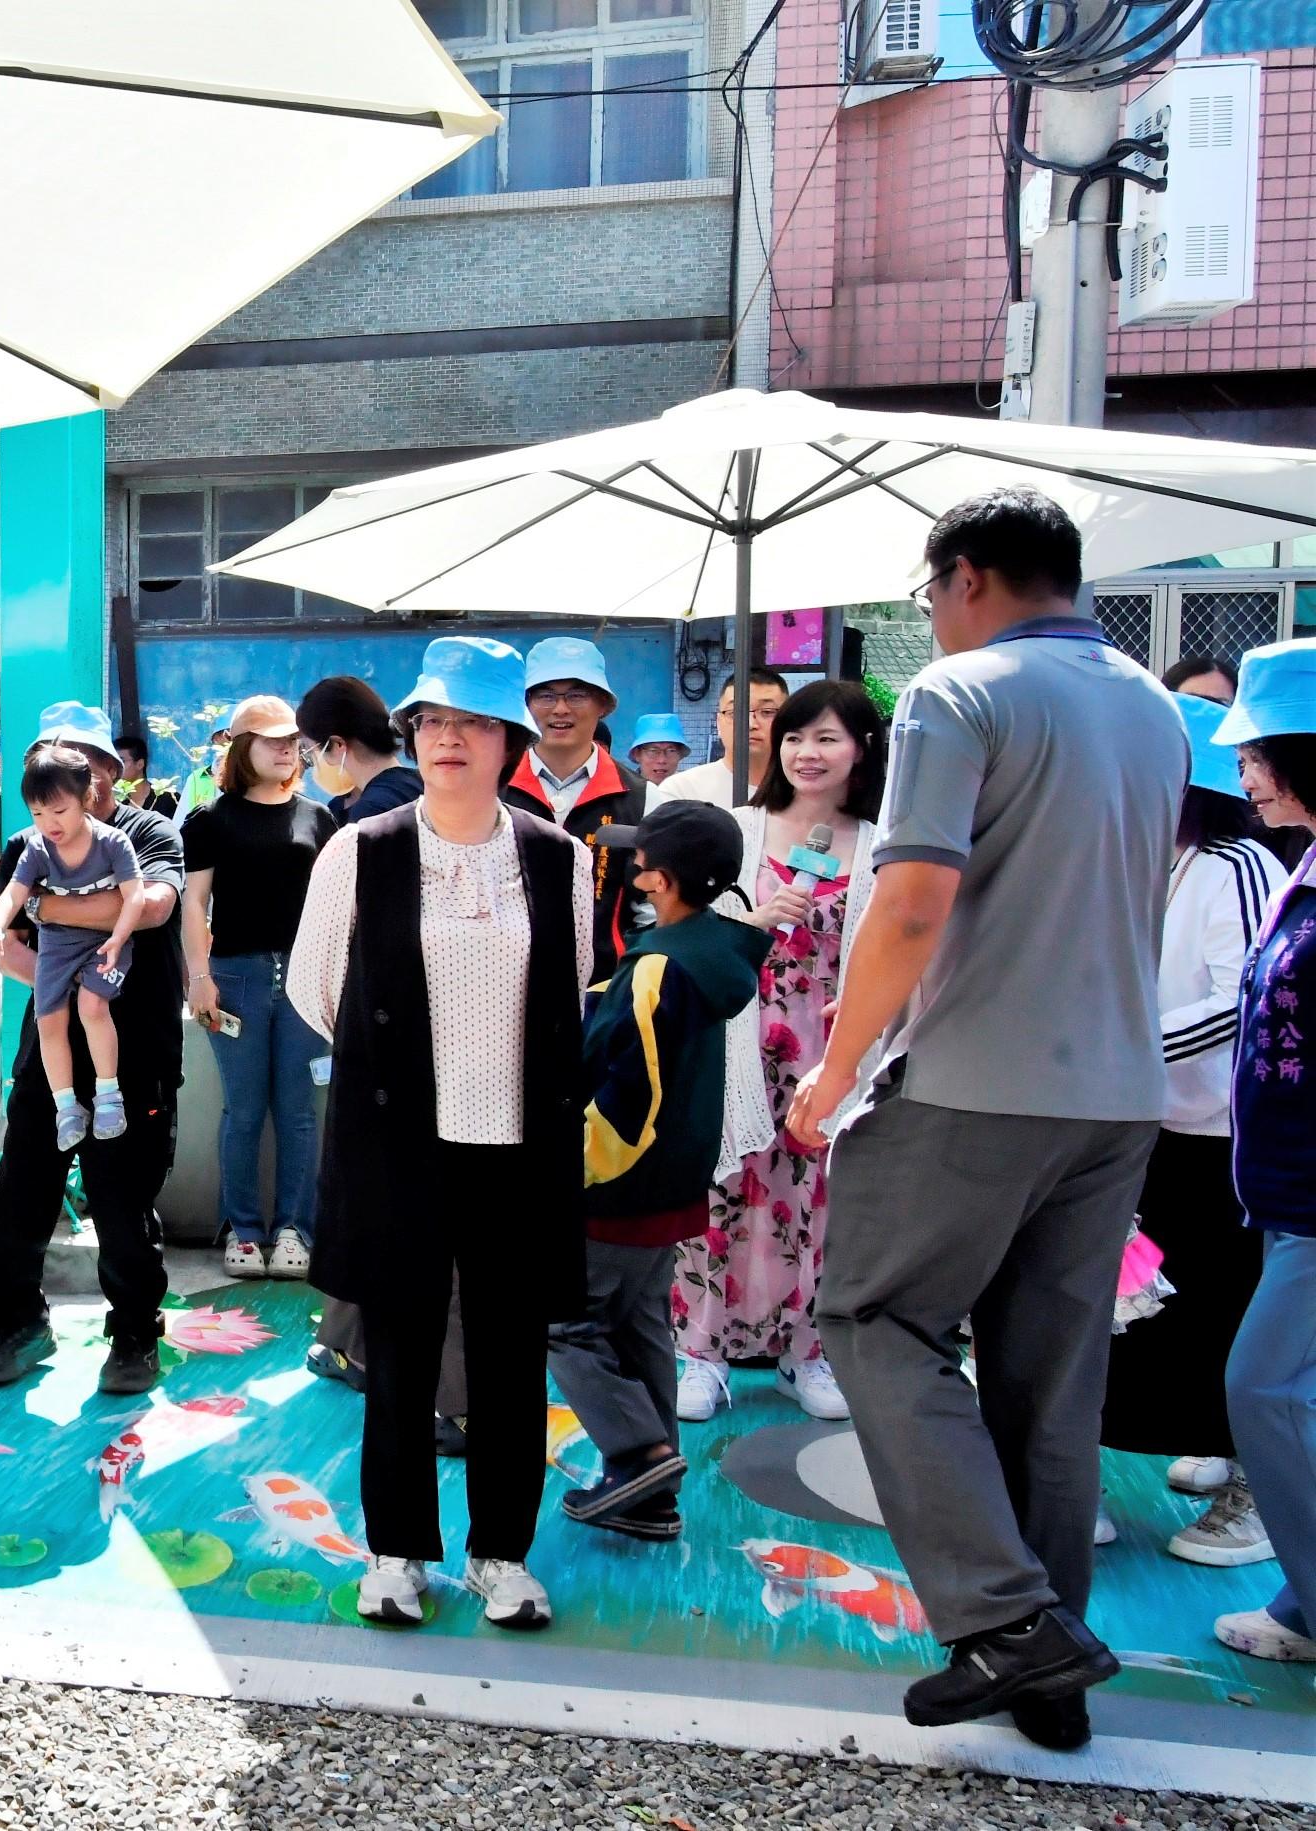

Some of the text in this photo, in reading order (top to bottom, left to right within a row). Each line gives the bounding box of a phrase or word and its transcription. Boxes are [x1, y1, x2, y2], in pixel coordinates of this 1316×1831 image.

[1273, 917, 1316, 1084] 芳苑鄉公所
